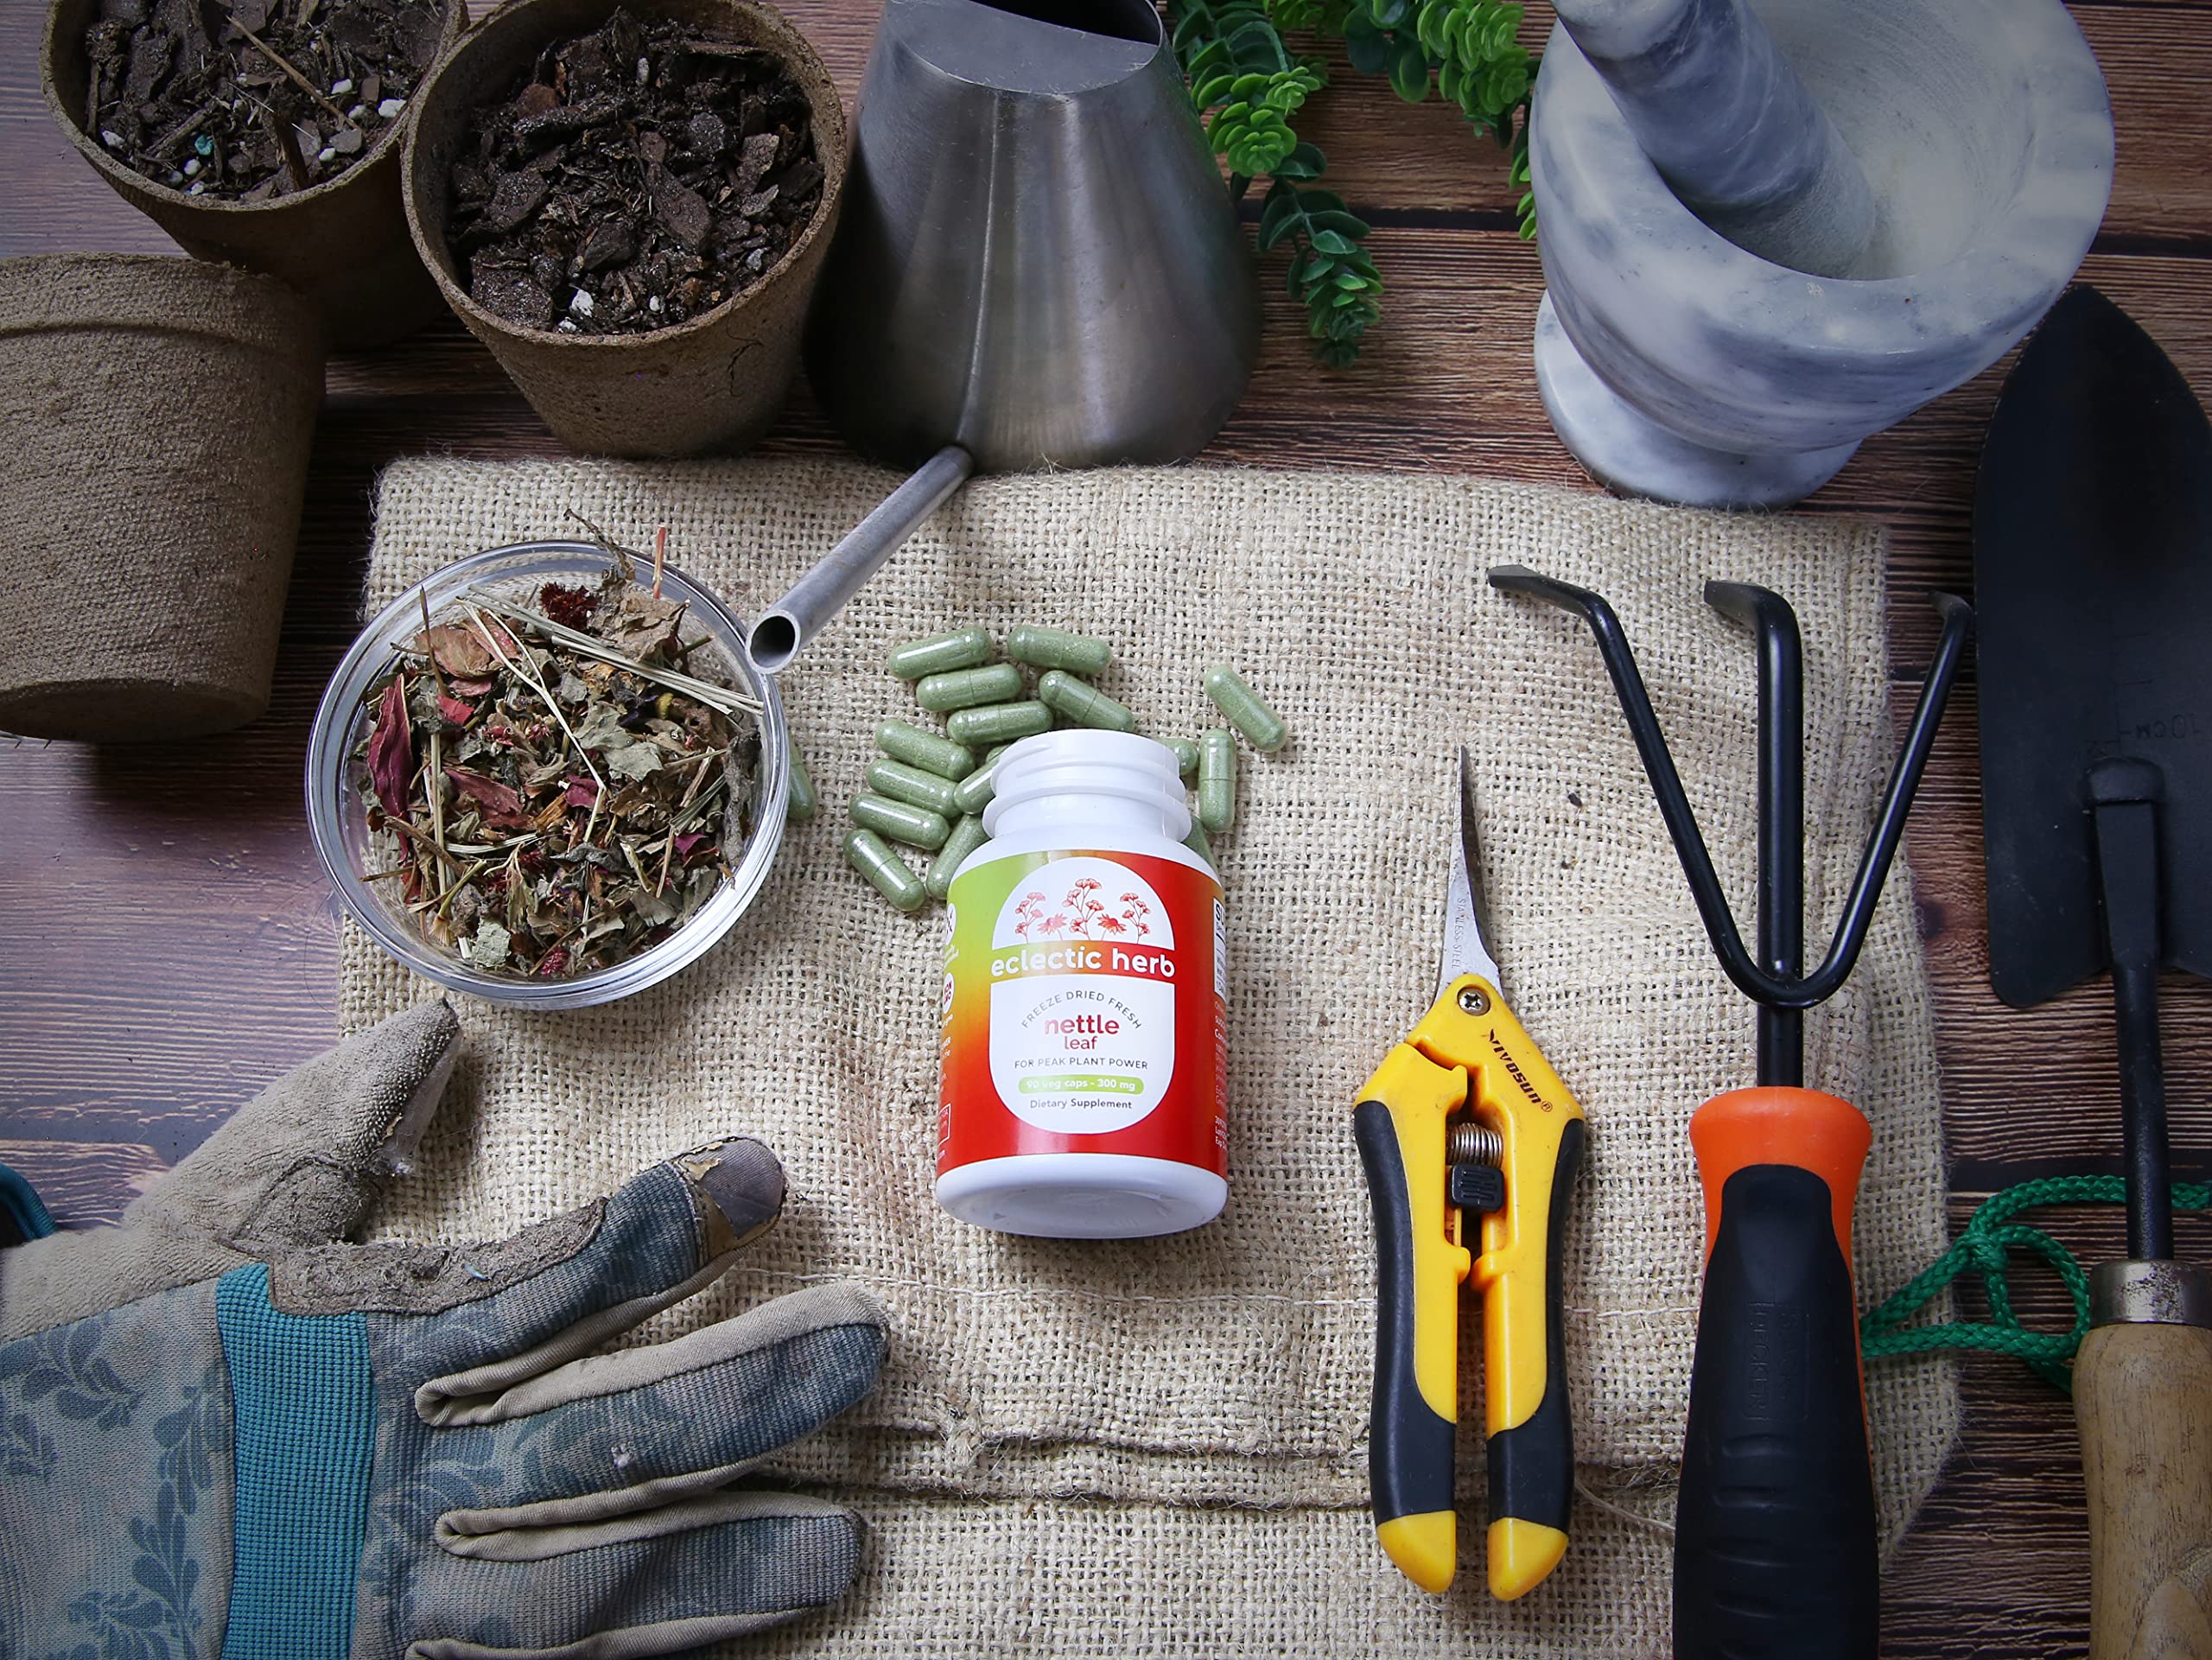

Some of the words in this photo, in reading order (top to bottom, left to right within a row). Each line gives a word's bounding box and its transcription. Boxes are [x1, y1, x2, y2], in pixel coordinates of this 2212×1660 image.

[991, 946, 1102, 977] eclectic
[1112, 947, 1175, 977] herb
[1452, 944, 1463, 968] STEEL
[1021, 994, 1062, 1028] FREEZE
[1065, 989, 1104, 1002] DRIED
[1108, 997, 1142, 1029] FRESH
[1045, 1014, 1120, 1035] nettle
[1065, 1035, 1098, 1050] leaf
[1014, 1059, 1034, 1069] FOR
[1038, 1058, 1065, 1066] PEAK
[1070, 1057, 1106, 1065] PLANT
[1109, 1058, 1148, 1069] POWER
[1064, 1079, 1088, 1089] caps
[1097, 1078, 1117, 1089] 300
[1119, 1080, 1135, 1091] mg
[1030, 1099, 1067, 1109] Dietary
[1071, 1098, 1133, 1110] Supplement
